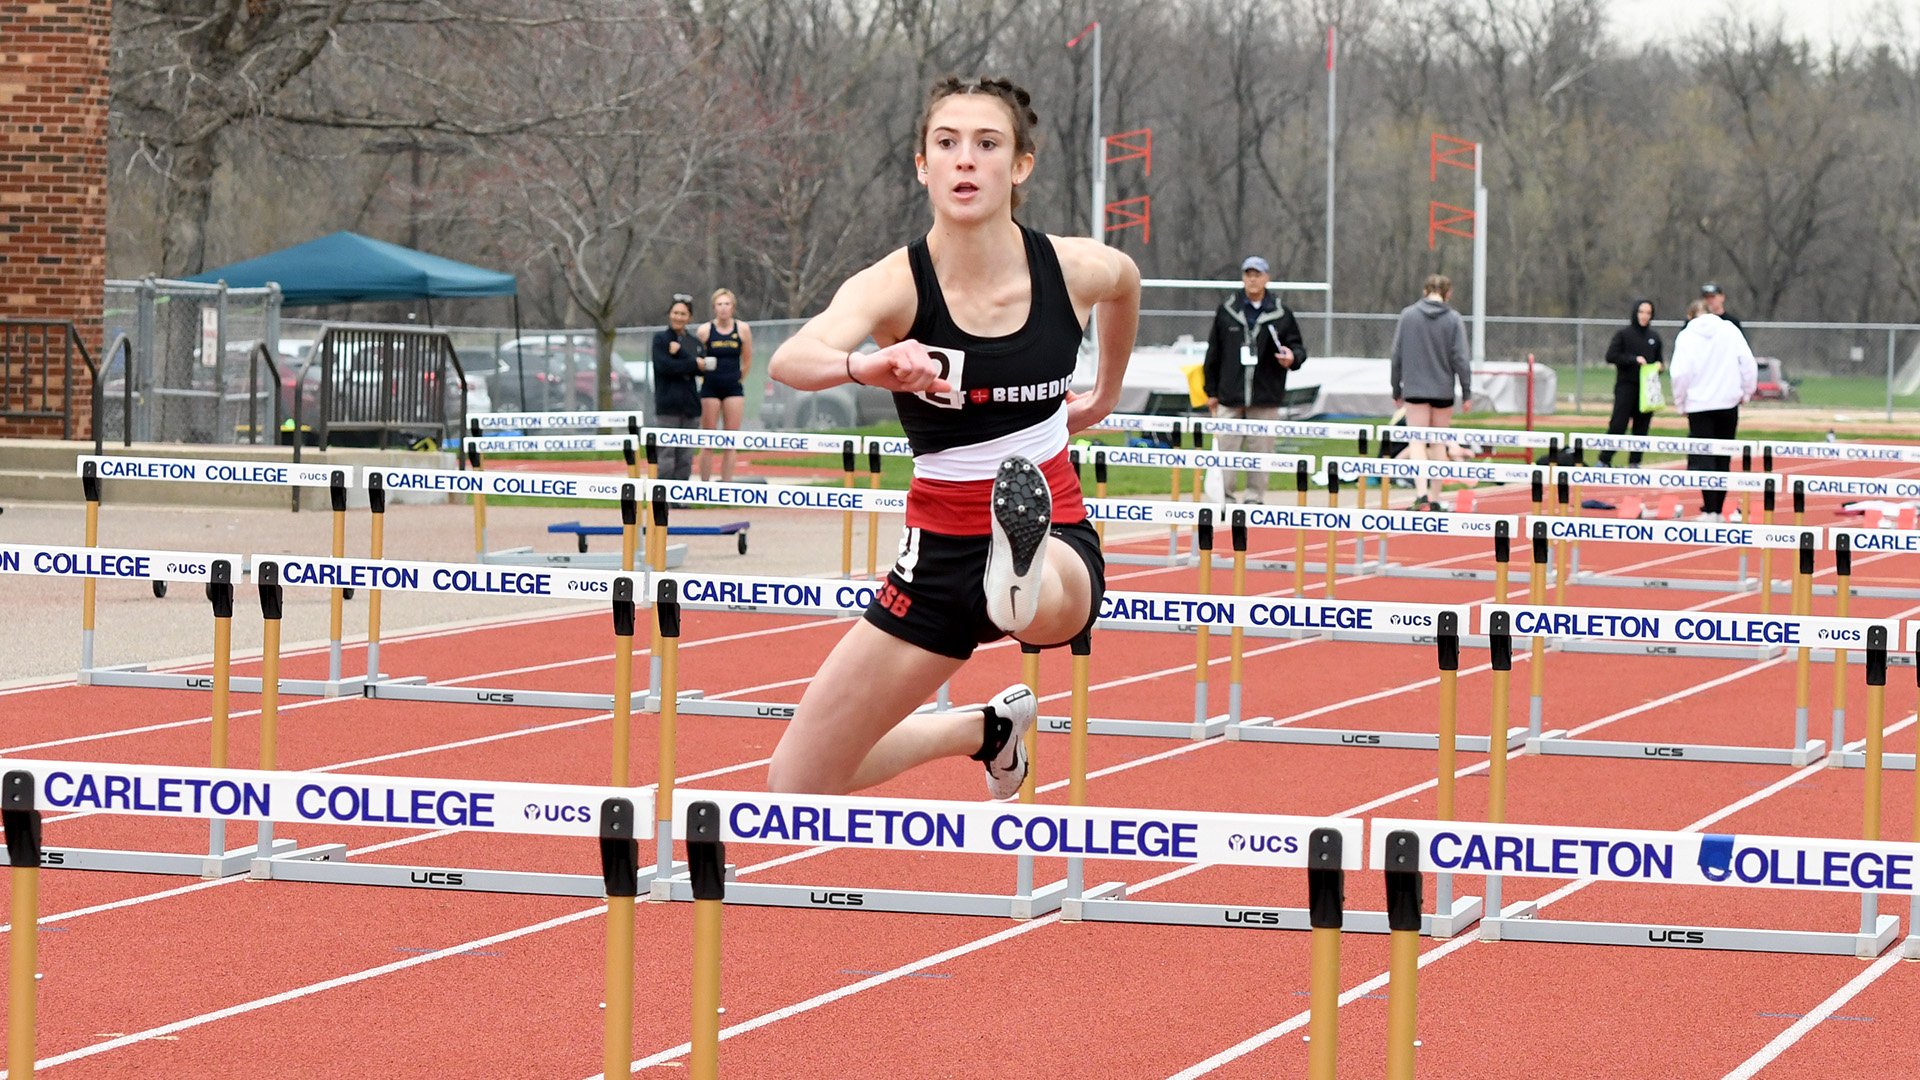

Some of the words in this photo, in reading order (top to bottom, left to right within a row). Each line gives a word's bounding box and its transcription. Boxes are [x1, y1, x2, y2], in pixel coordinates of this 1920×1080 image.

[481, 416, 541, 427] CARLETON
[548, 416, 600, 425] COLLEGE
[1205, 422, 1268, 433] CARLETON
[1275, 425, 1329, 436] COLLEGE
[479, 440, 538, 450] CARLETON
[545, 440, 596, 449] COLLEGE
[660, 433, 735, 446] CARLETON
[743, 436, 808, 449] COLLEGE
[1393, 430, 1457, 441] CARLETON
[1464, 433, 1519, 444] COLLEGE
[1585, 438, 1650, 449] CARLETON
[1657, 441, 1713, 453] COLLEGE
[883, 441, 911, 453] CAR
[1775, 445, 1840, 456] CARLETON
[1847, 448, 1903, 460] COLLEGE
[1109, 451, 1186, 466] CARLETON
[1195, 455, 1261, 468] COLLEGE
[101, 461, 195, 479] CARLETON
[206, 466, 287, 482] COLLEGE
[310, 473, 328, 481] UCS
[1342, 461, 1420, 475] CARLETON
[1428, 465, 1495, 479] COLLEGE
[387, 473, 482, 491] CARLETON
[493, 478, 576, 495] COLLEGE
[1571, 471, 1650, 486] CARLETON
[1659, 474, 1727, 488] COLLEGE
[1807, 480, 1887, 496] CARLETON
[670, 485, 767, 504] CARLETON
[778, 491, 863, 508] COLLEGE
[1084, 503, 1153, 521] OLLEGE
[1250, 510, 1350, 528] CARLETON
[1362, 515, 1448, 532] COLLEGE
[1471, 523, 1491, 531] UCS
[1552, 522, 1653, 540] CARLETON
[1665, 527, 1753, 544] COLLEGE
[1775, 534, 1796, 542] UCS
[1854, 533, 1920, 550] CARLE
[34, 552, 150, 577] COLLEGE
[179, 564, 206, 575] UCS
[283, 562, 418, 588] CARLETON
[433, 569, 551, 595] COLLEGE
[581, 581, 608, 592] UCS
[683, 580, 821, 608] CARLETON
[1098, 597, 1234, 624] CARLETON
[1250, 604, 1372, 629] COLLEGE
[1403, 616, 1432, 626] UCS
[1515, 612, 1659, 638] CARLETON
[1675, 618, 1800, 644] COLLEGE
[1831, 630, 1861, 641] UCS
[477, 691, 513, 701] UCS
[757, 707, 795, 717] UCS
[1341, 733, 1380, 745] UCS
[1644, 747, 1683, 757] UCS
[44, 772, 270, 816] CARLETON
[296, 784, 494, 827] COLLEGE
[545, 805, 591, 823] UCS
[729, 802, 965, 848] CARLETON
[992, 814, 1198, 858] COLLEGE
[1250, 835, 1298, 853] UCS
[1430, 832, 1673, 879] CARLETON
[411, 872, 463, 886] UCS
[811, 891, 863, 906] UCS
[1225, 910, 1279, 925] UCS
[1648, 929, 1704, 945] UCS
